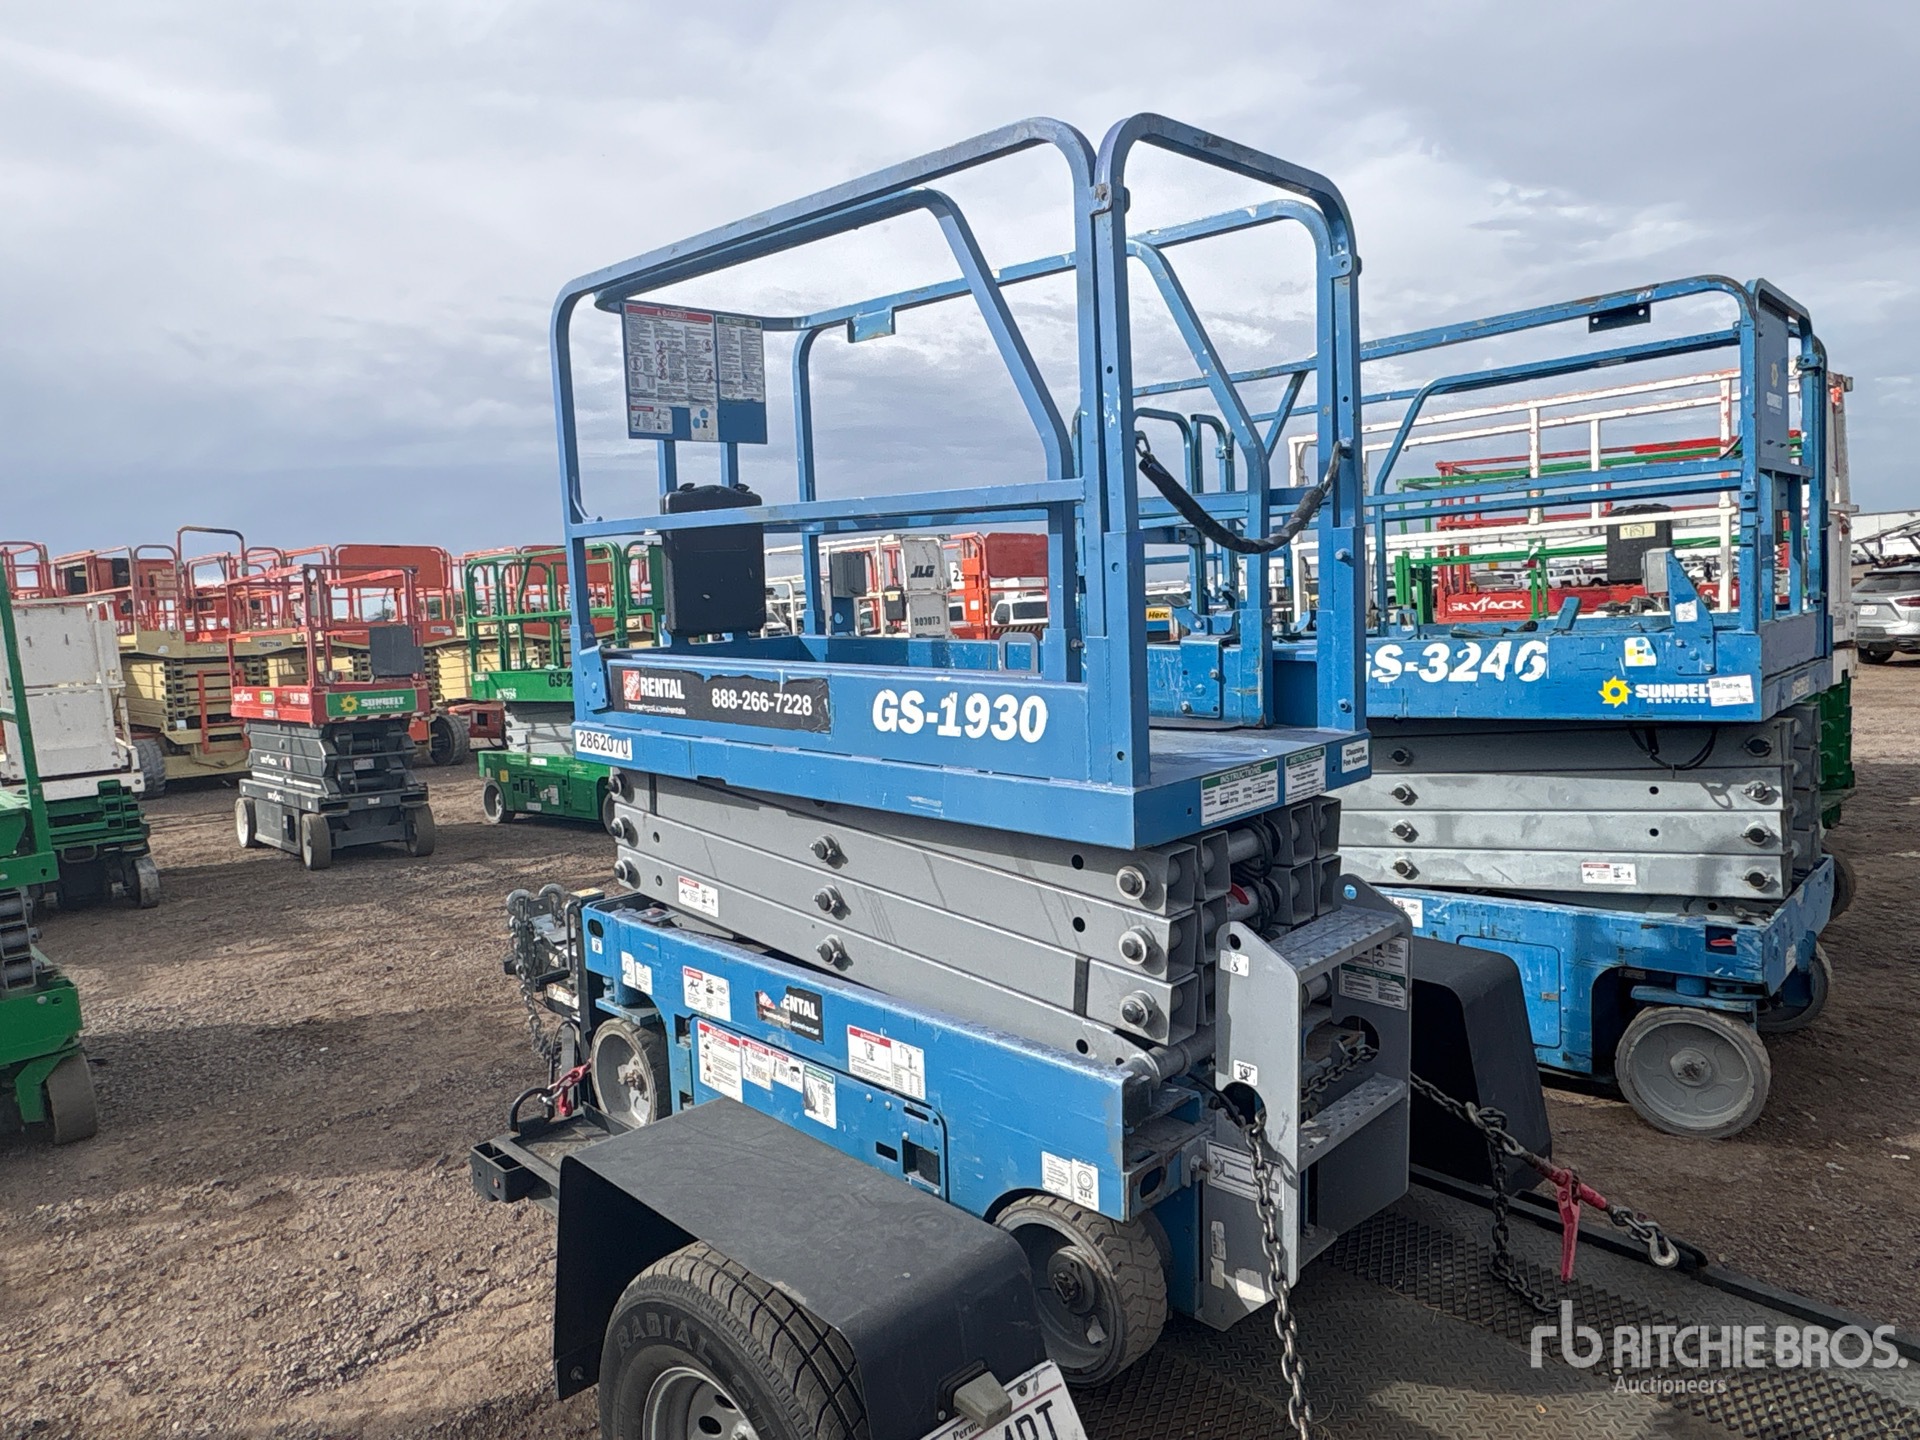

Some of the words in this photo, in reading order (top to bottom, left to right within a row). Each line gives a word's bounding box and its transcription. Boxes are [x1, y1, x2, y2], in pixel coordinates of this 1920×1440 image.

[910, 565, 935, 578] JLG
[1449, 597, 1525, 612] SKYJACK
[640, 677, 686, 700] RENTAL
[1635, 683, 1710, 698] SUNBEL
[360, 696, 405, 707] SUNBELT
[711, 688, 813, 717] 888-266-7228
[872, 689, 1048, 743] GS-1930
[579, 731, 629, 755] 2862070
[1219, 765, 1263, 784] INSTRUCTIONS
[616, 1311, 713, 1367] RADIAL
